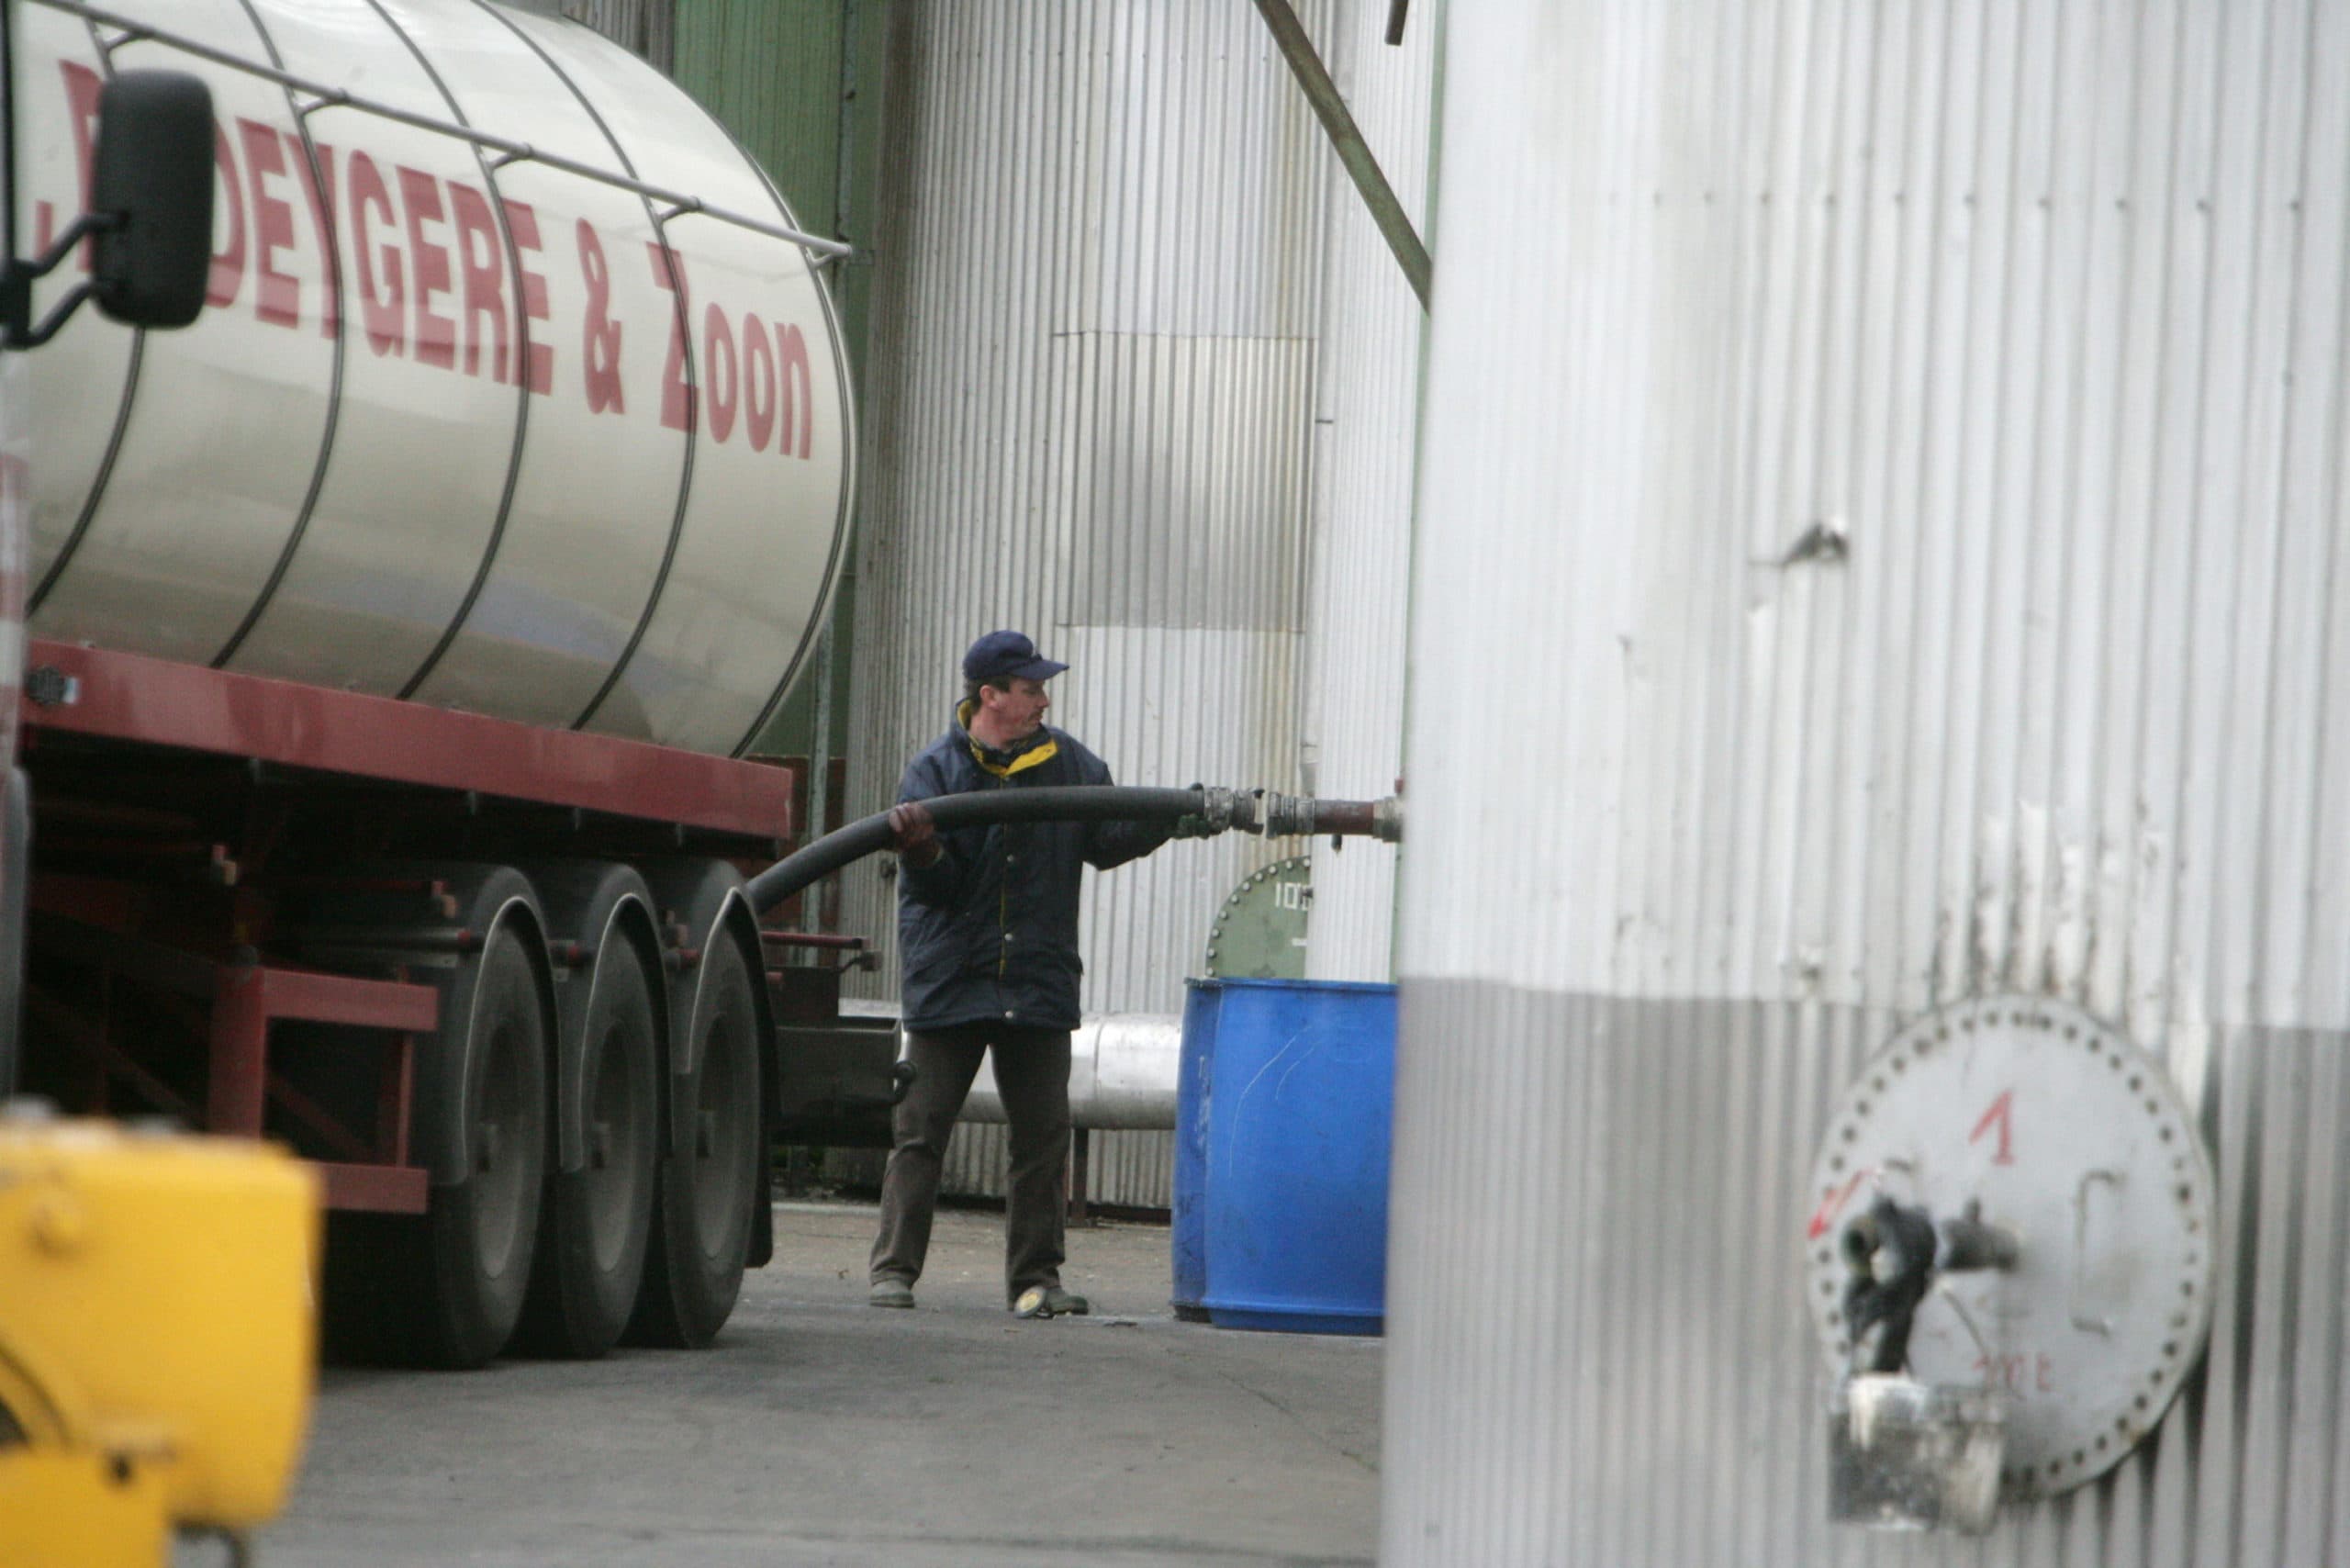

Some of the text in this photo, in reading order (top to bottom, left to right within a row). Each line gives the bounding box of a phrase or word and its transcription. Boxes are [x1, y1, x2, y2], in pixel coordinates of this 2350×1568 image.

[576, 217, 625, 415] &
[645, 241, 813, 460] Zoon
[1967, 1089, 2017, 1165] 1
